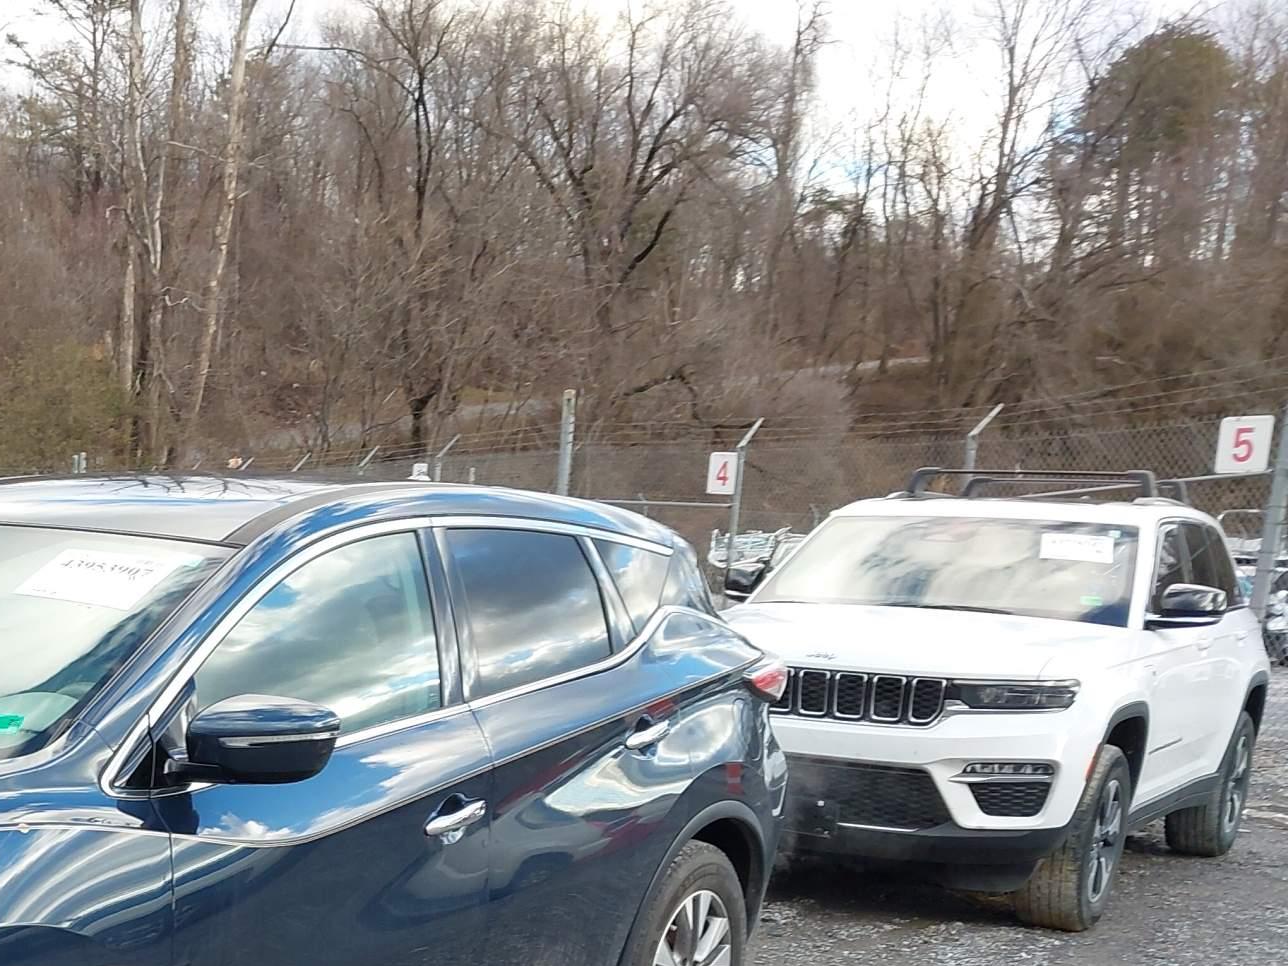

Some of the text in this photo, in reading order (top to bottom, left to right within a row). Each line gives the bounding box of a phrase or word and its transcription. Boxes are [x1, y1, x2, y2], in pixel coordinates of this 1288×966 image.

[1233, 427, 1255, 463] 5
[716, 460, 728, 486] 4
[61, 558, 154, 577] 43953907
